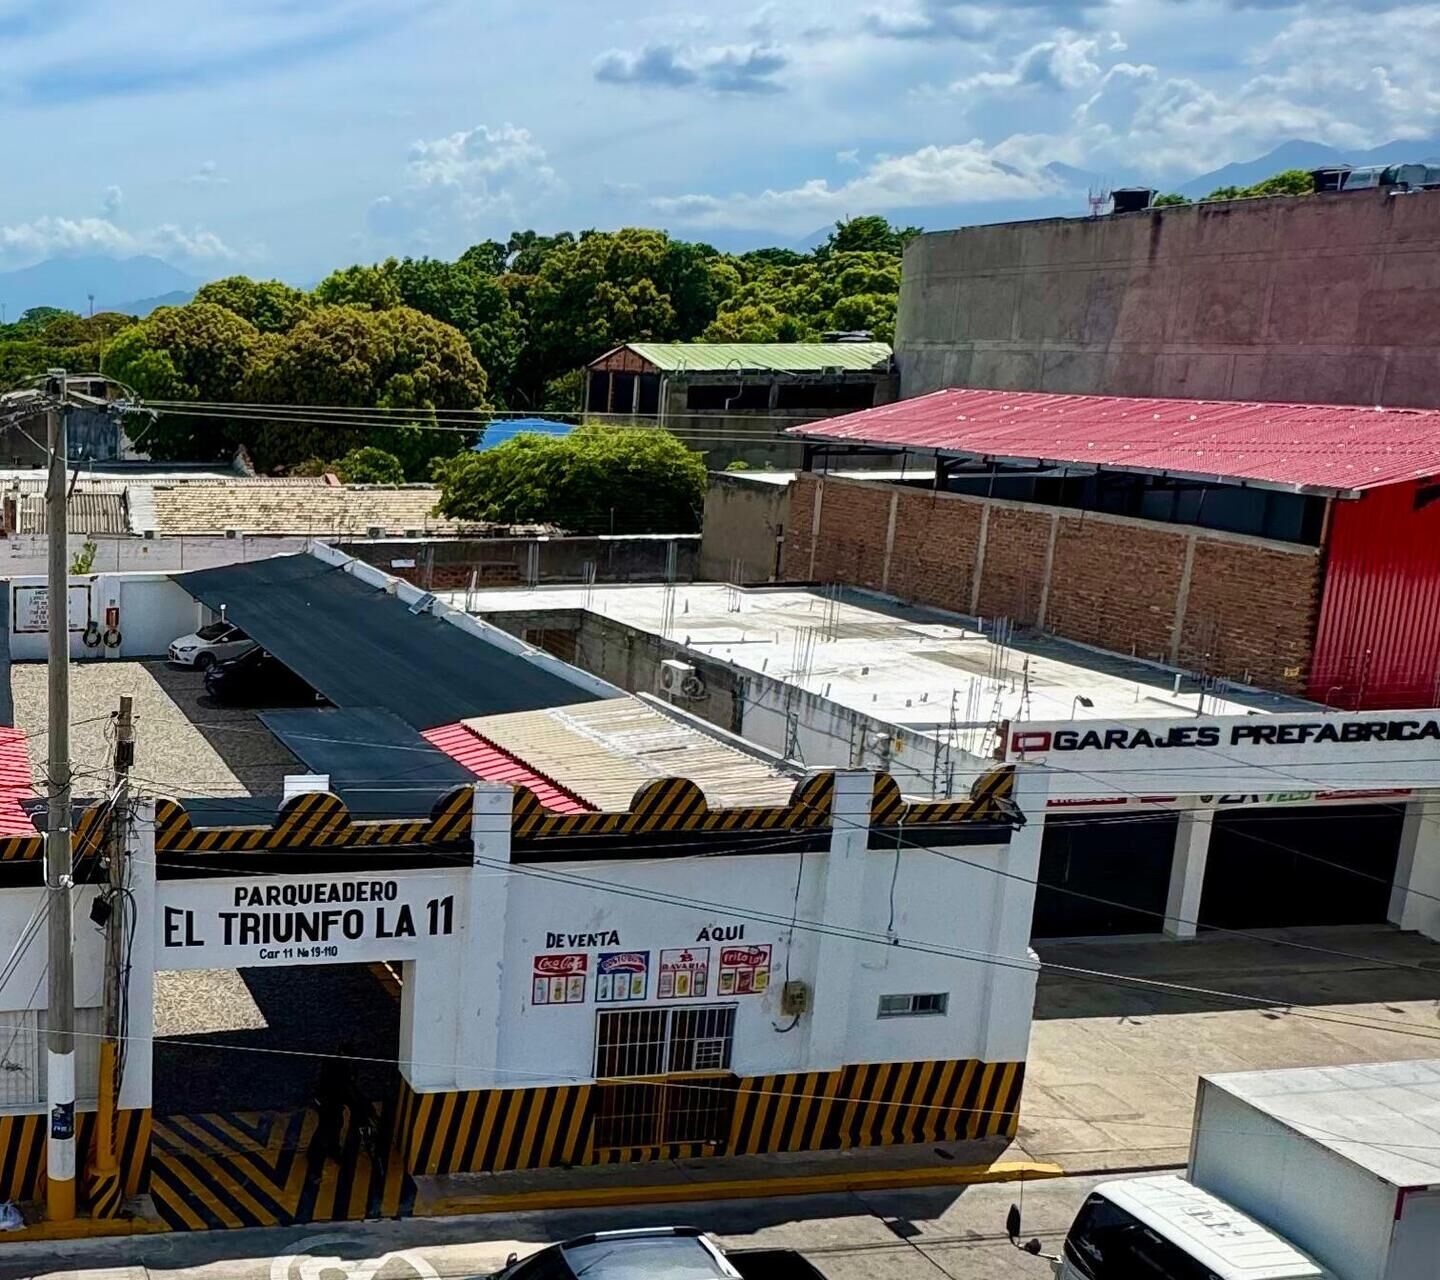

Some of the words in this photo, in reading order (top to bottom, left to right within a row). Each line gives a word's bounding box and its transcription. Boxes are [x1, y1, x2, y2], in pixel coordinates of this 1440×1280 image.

[1053, 726, 1220, 751] GARAJES
[1230, 720, 1440, 745] PREFABRICA
[234, 881, 398, 907] PARQUEADERO
[164, 905, 205, 948] EL
[218, 909, 365, 946] TRIUNFO
[375, 904, 416, 939] LA
[426, 895, 454, 936] 11
[568, 930, 620, 947] VENTA
[696, 924, 745, 942] AQUI
[260, 948, 280, 959] Car
[283, 948, 293, 958] 11
[311, 945, 338, 957] 19-110
[661, 962, 706, 970] BAVARIA
